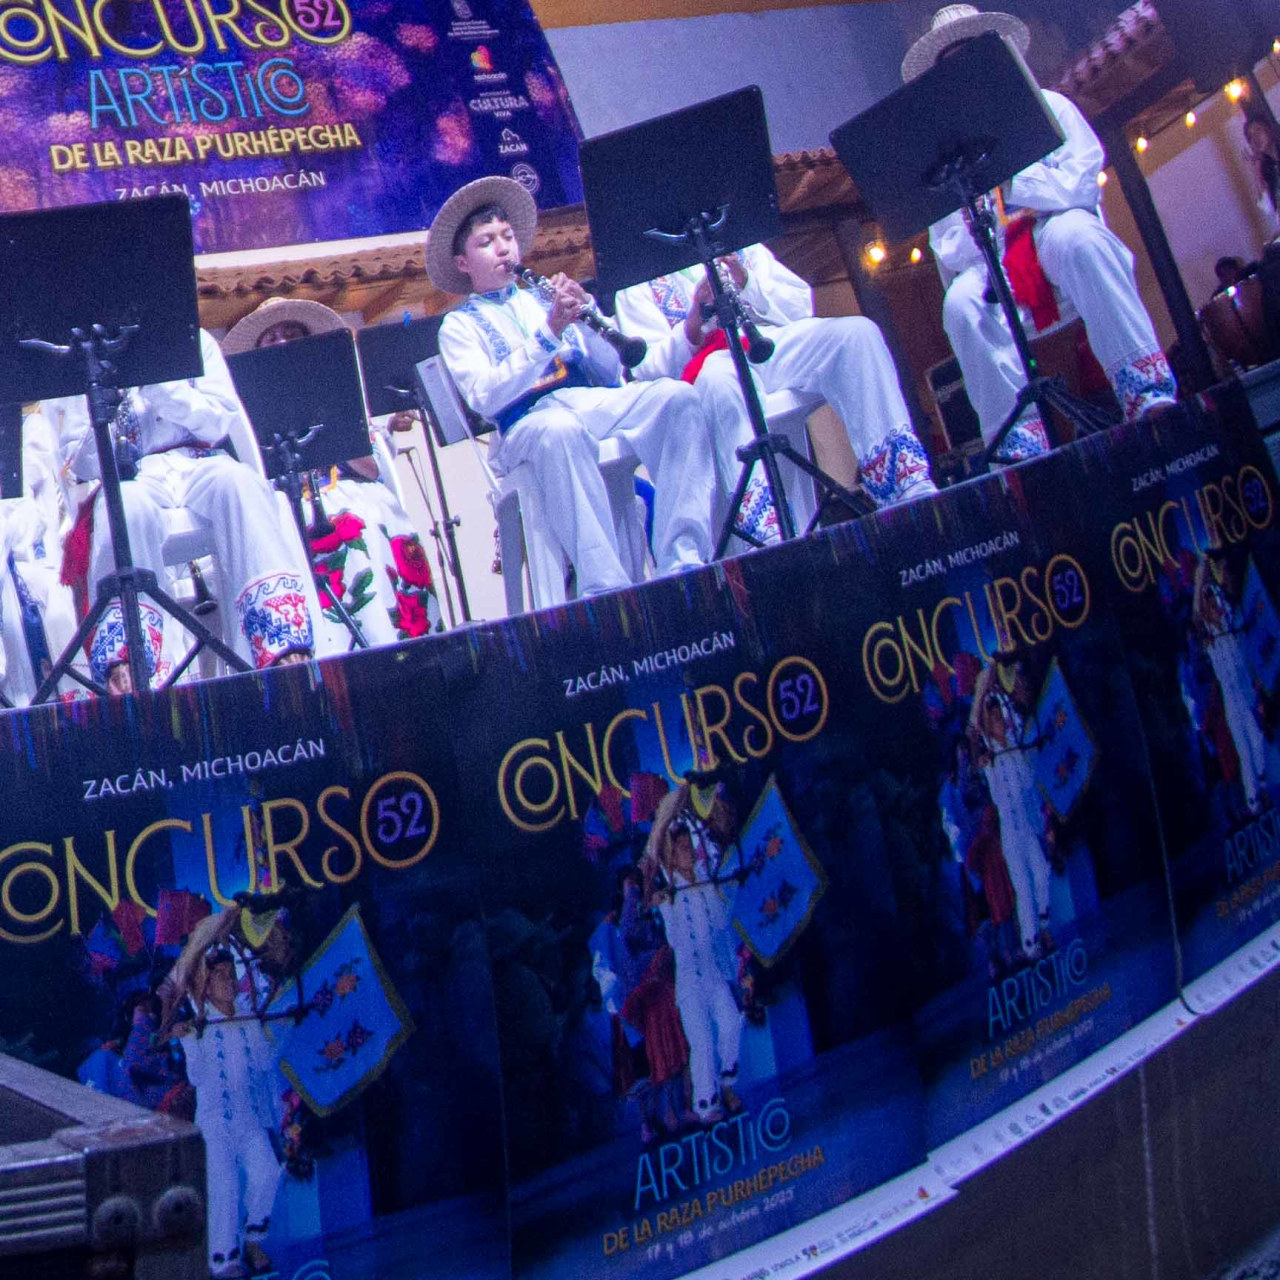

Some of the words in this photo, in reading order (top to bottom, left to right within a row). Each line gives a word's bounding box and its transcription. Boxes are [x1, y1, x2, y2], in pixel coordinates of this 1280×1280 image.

[50, 144, 90, 172] DE
[93, 141, 123, 168] LA
[125, 136, 193, 165] RAZA
[200, 169, 326, 198] MICHOACÁN
[947, 530, 1021, 569] MICHOACÁN
[1052, 569, 1084, 610] 52
[562, 663, 630, 699] ZACÁN,
[632, 629, 736, 675] MICHOACÁN
[778, 672, 820, 720] 52
[83, 766, 174, 802] ZACÁN,
[182, 737, 326, 784] MICHOACÁN
[376, 791, 428, 844] 52
[602, 1226, 629, 1257] DE
[633, 1218, 653, 1244] LA
[656, 1197, 705, 1234] RAZA
